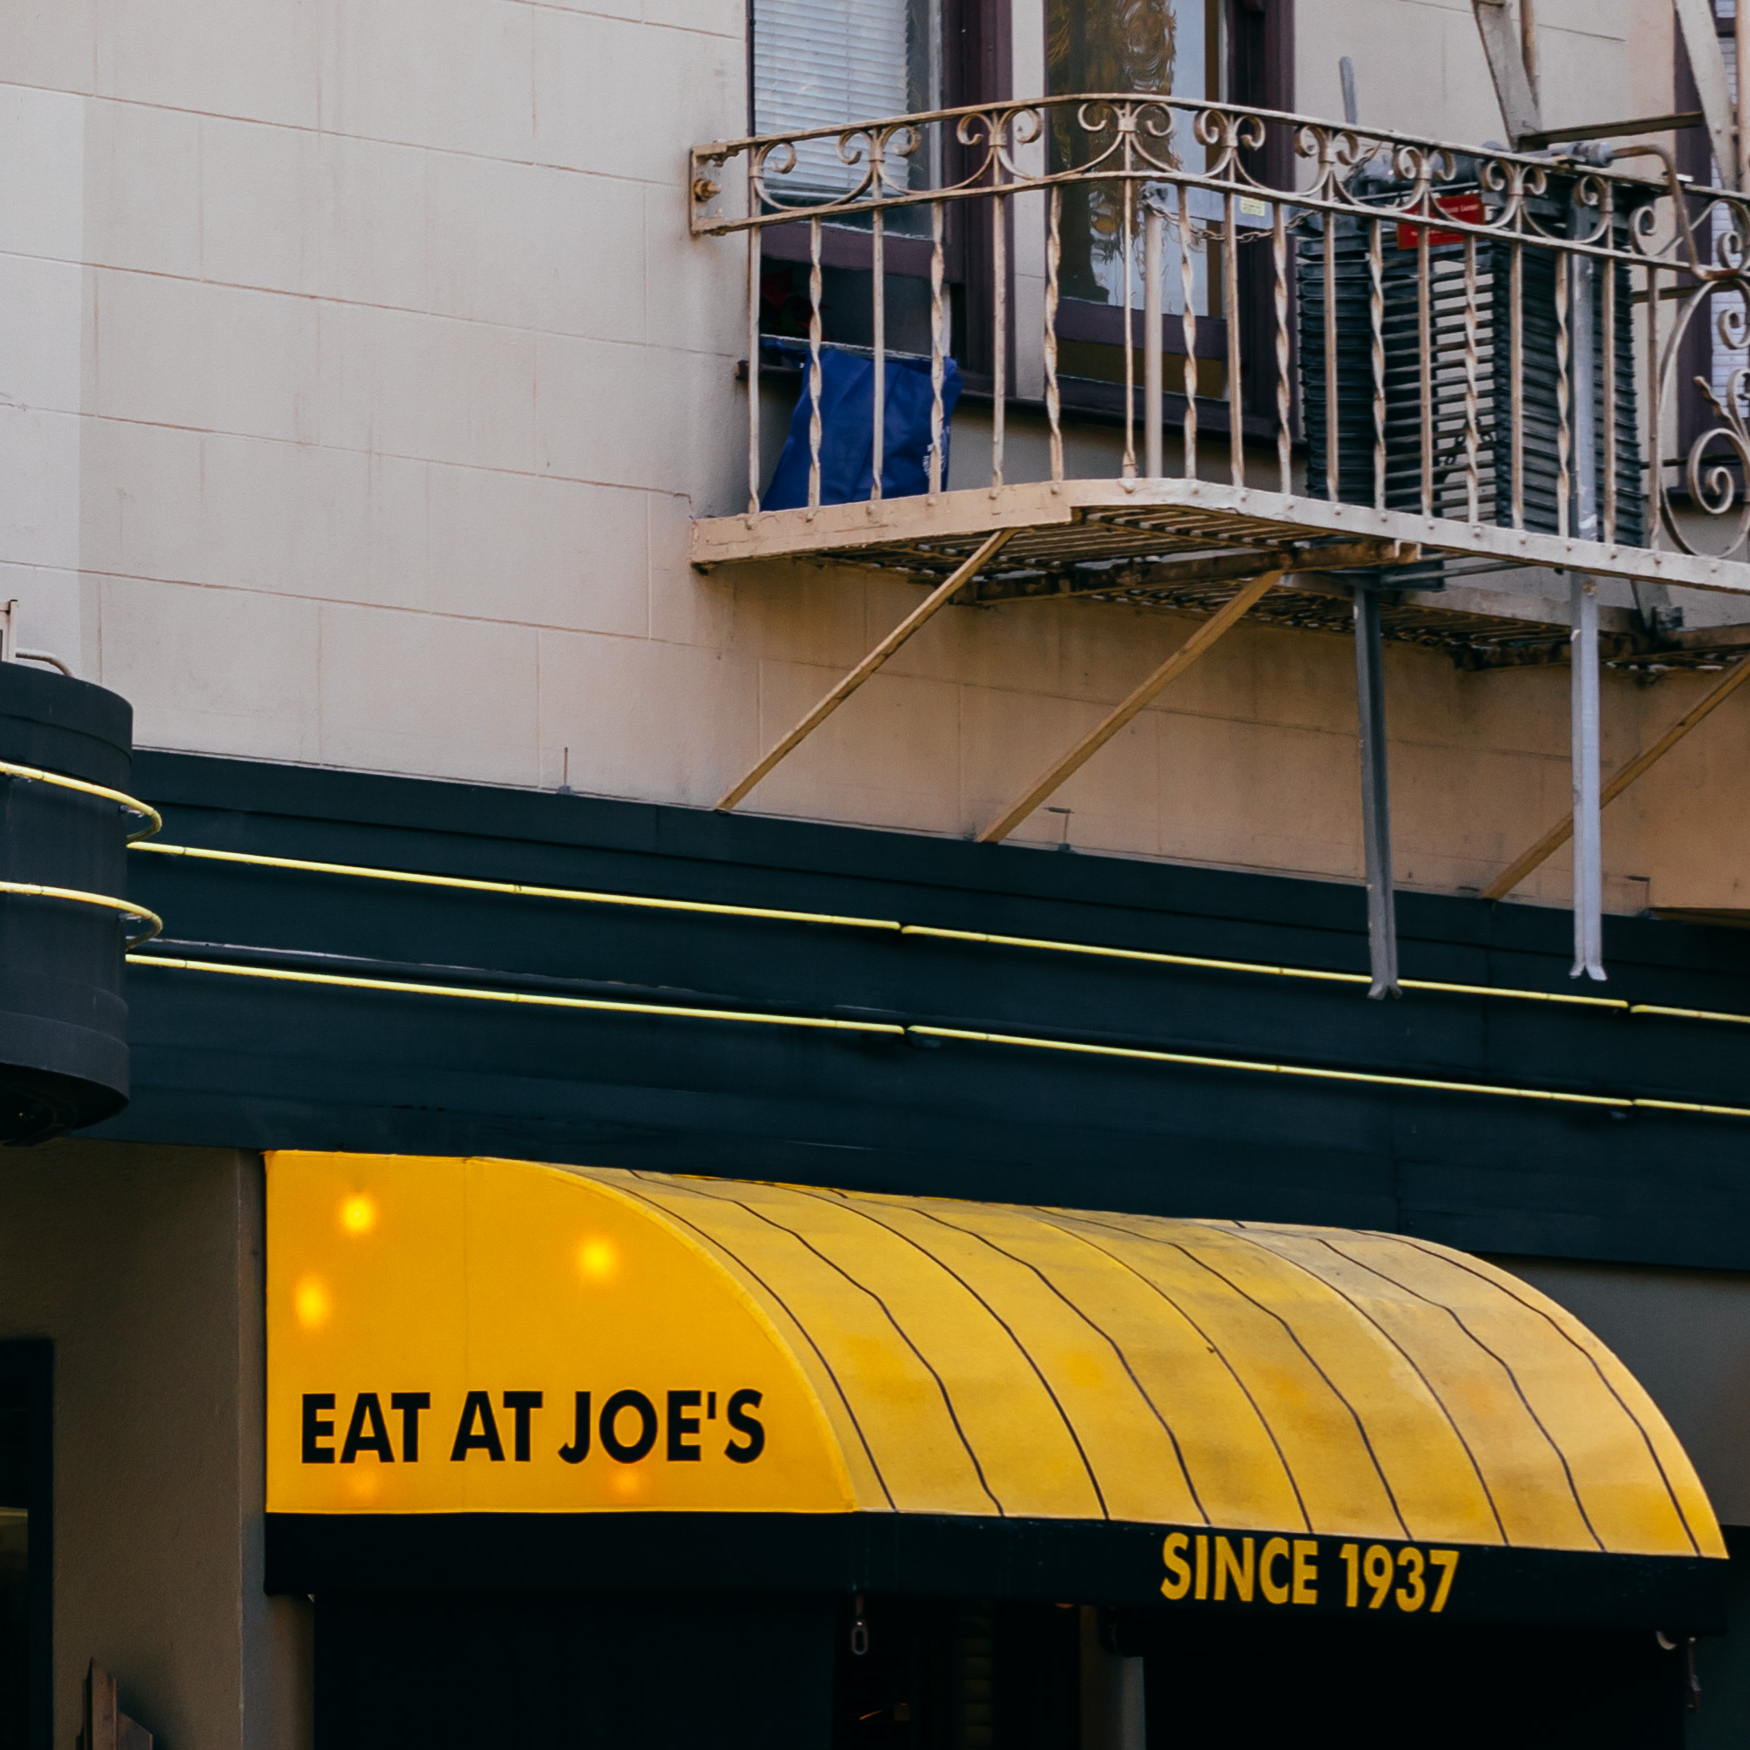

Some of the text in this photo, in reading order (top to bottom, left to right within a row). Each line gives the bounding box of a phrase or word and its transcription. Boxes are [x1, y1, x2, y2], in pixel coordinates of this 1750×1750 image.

[300, 1388, 766, 1465] EAT AT JOE'S
[1160, 1531, 1460, 1613] SINCE 1937
